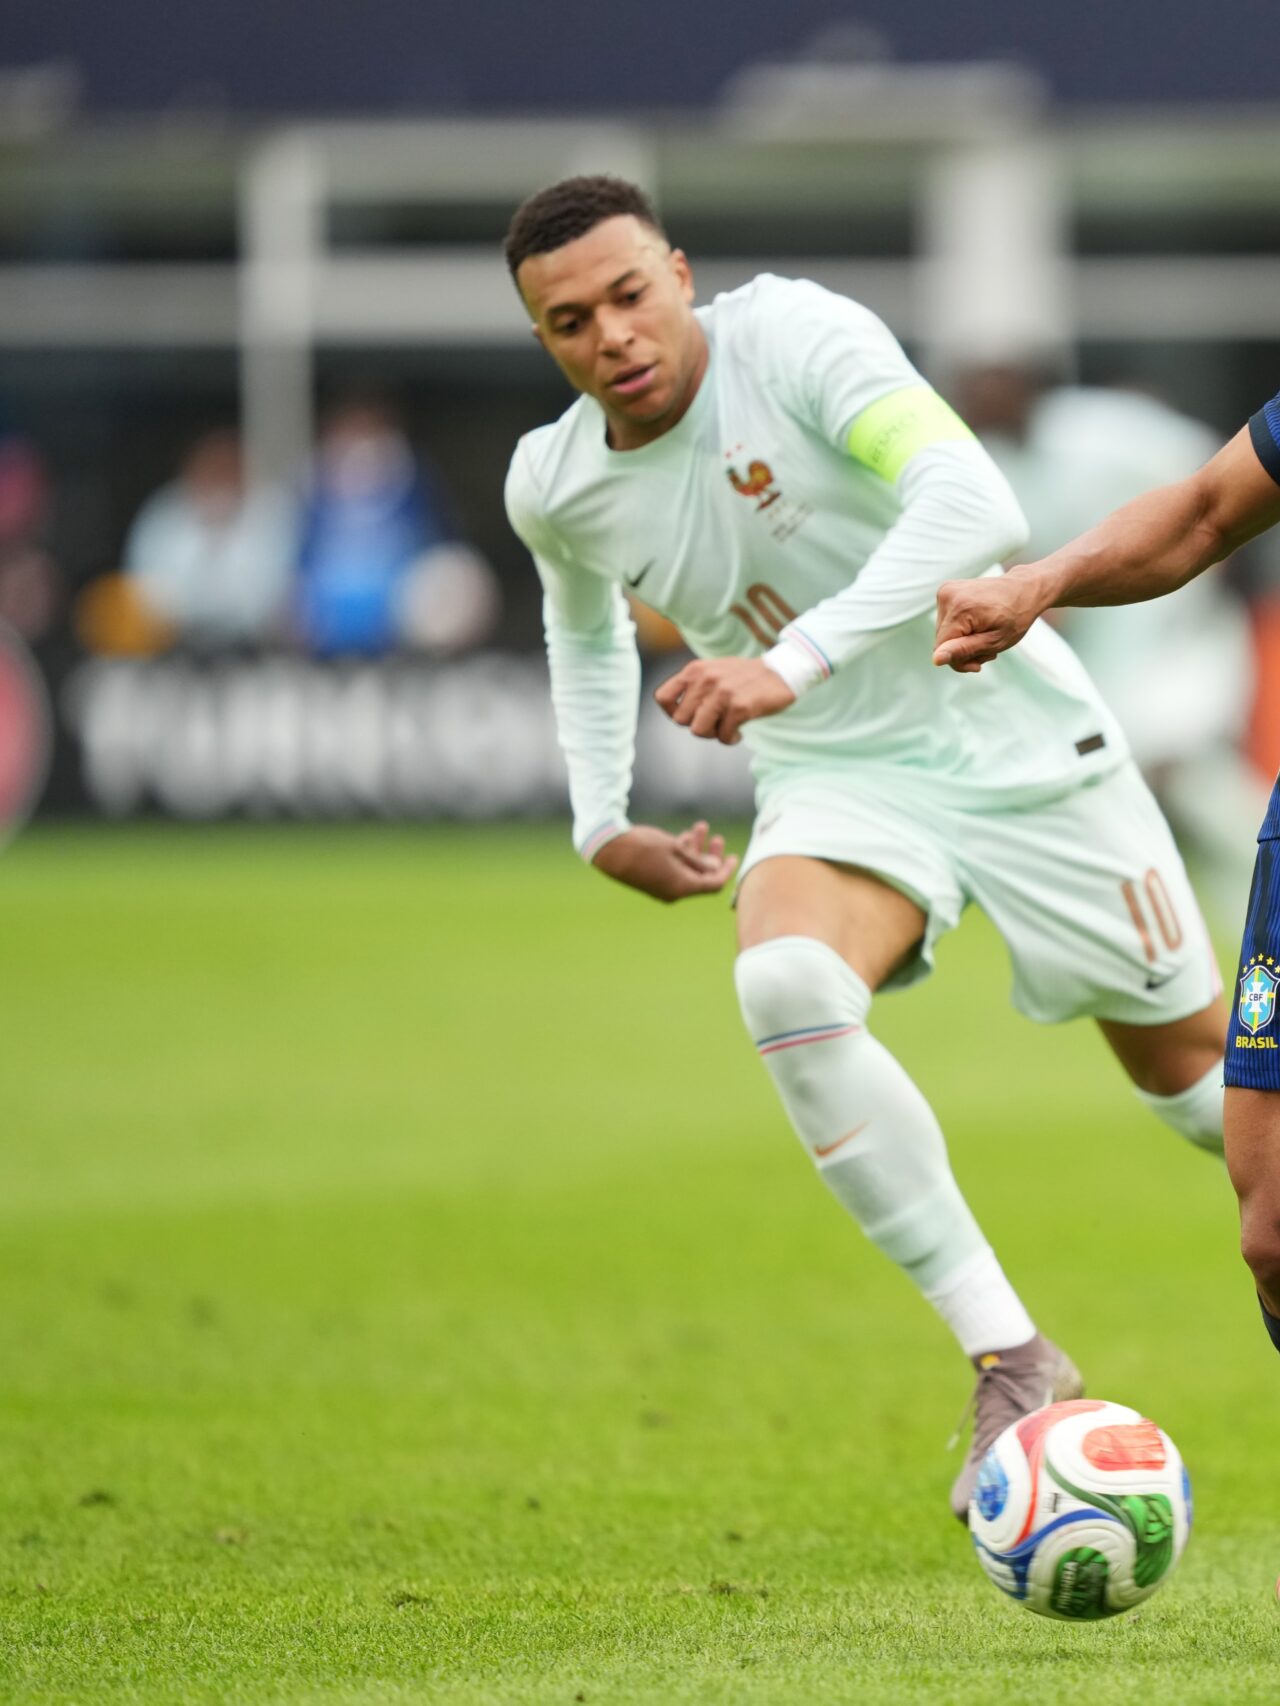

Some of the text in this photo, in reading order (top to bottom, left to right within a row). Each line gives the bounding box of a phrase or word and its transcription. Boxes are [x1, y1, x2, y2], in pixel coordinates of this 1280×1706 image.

[1120, 868, 1184, 963] 10
[1248, 993, 1264, 1002] CBF
[1235, 1035, 1279, 1049] BRASIL
